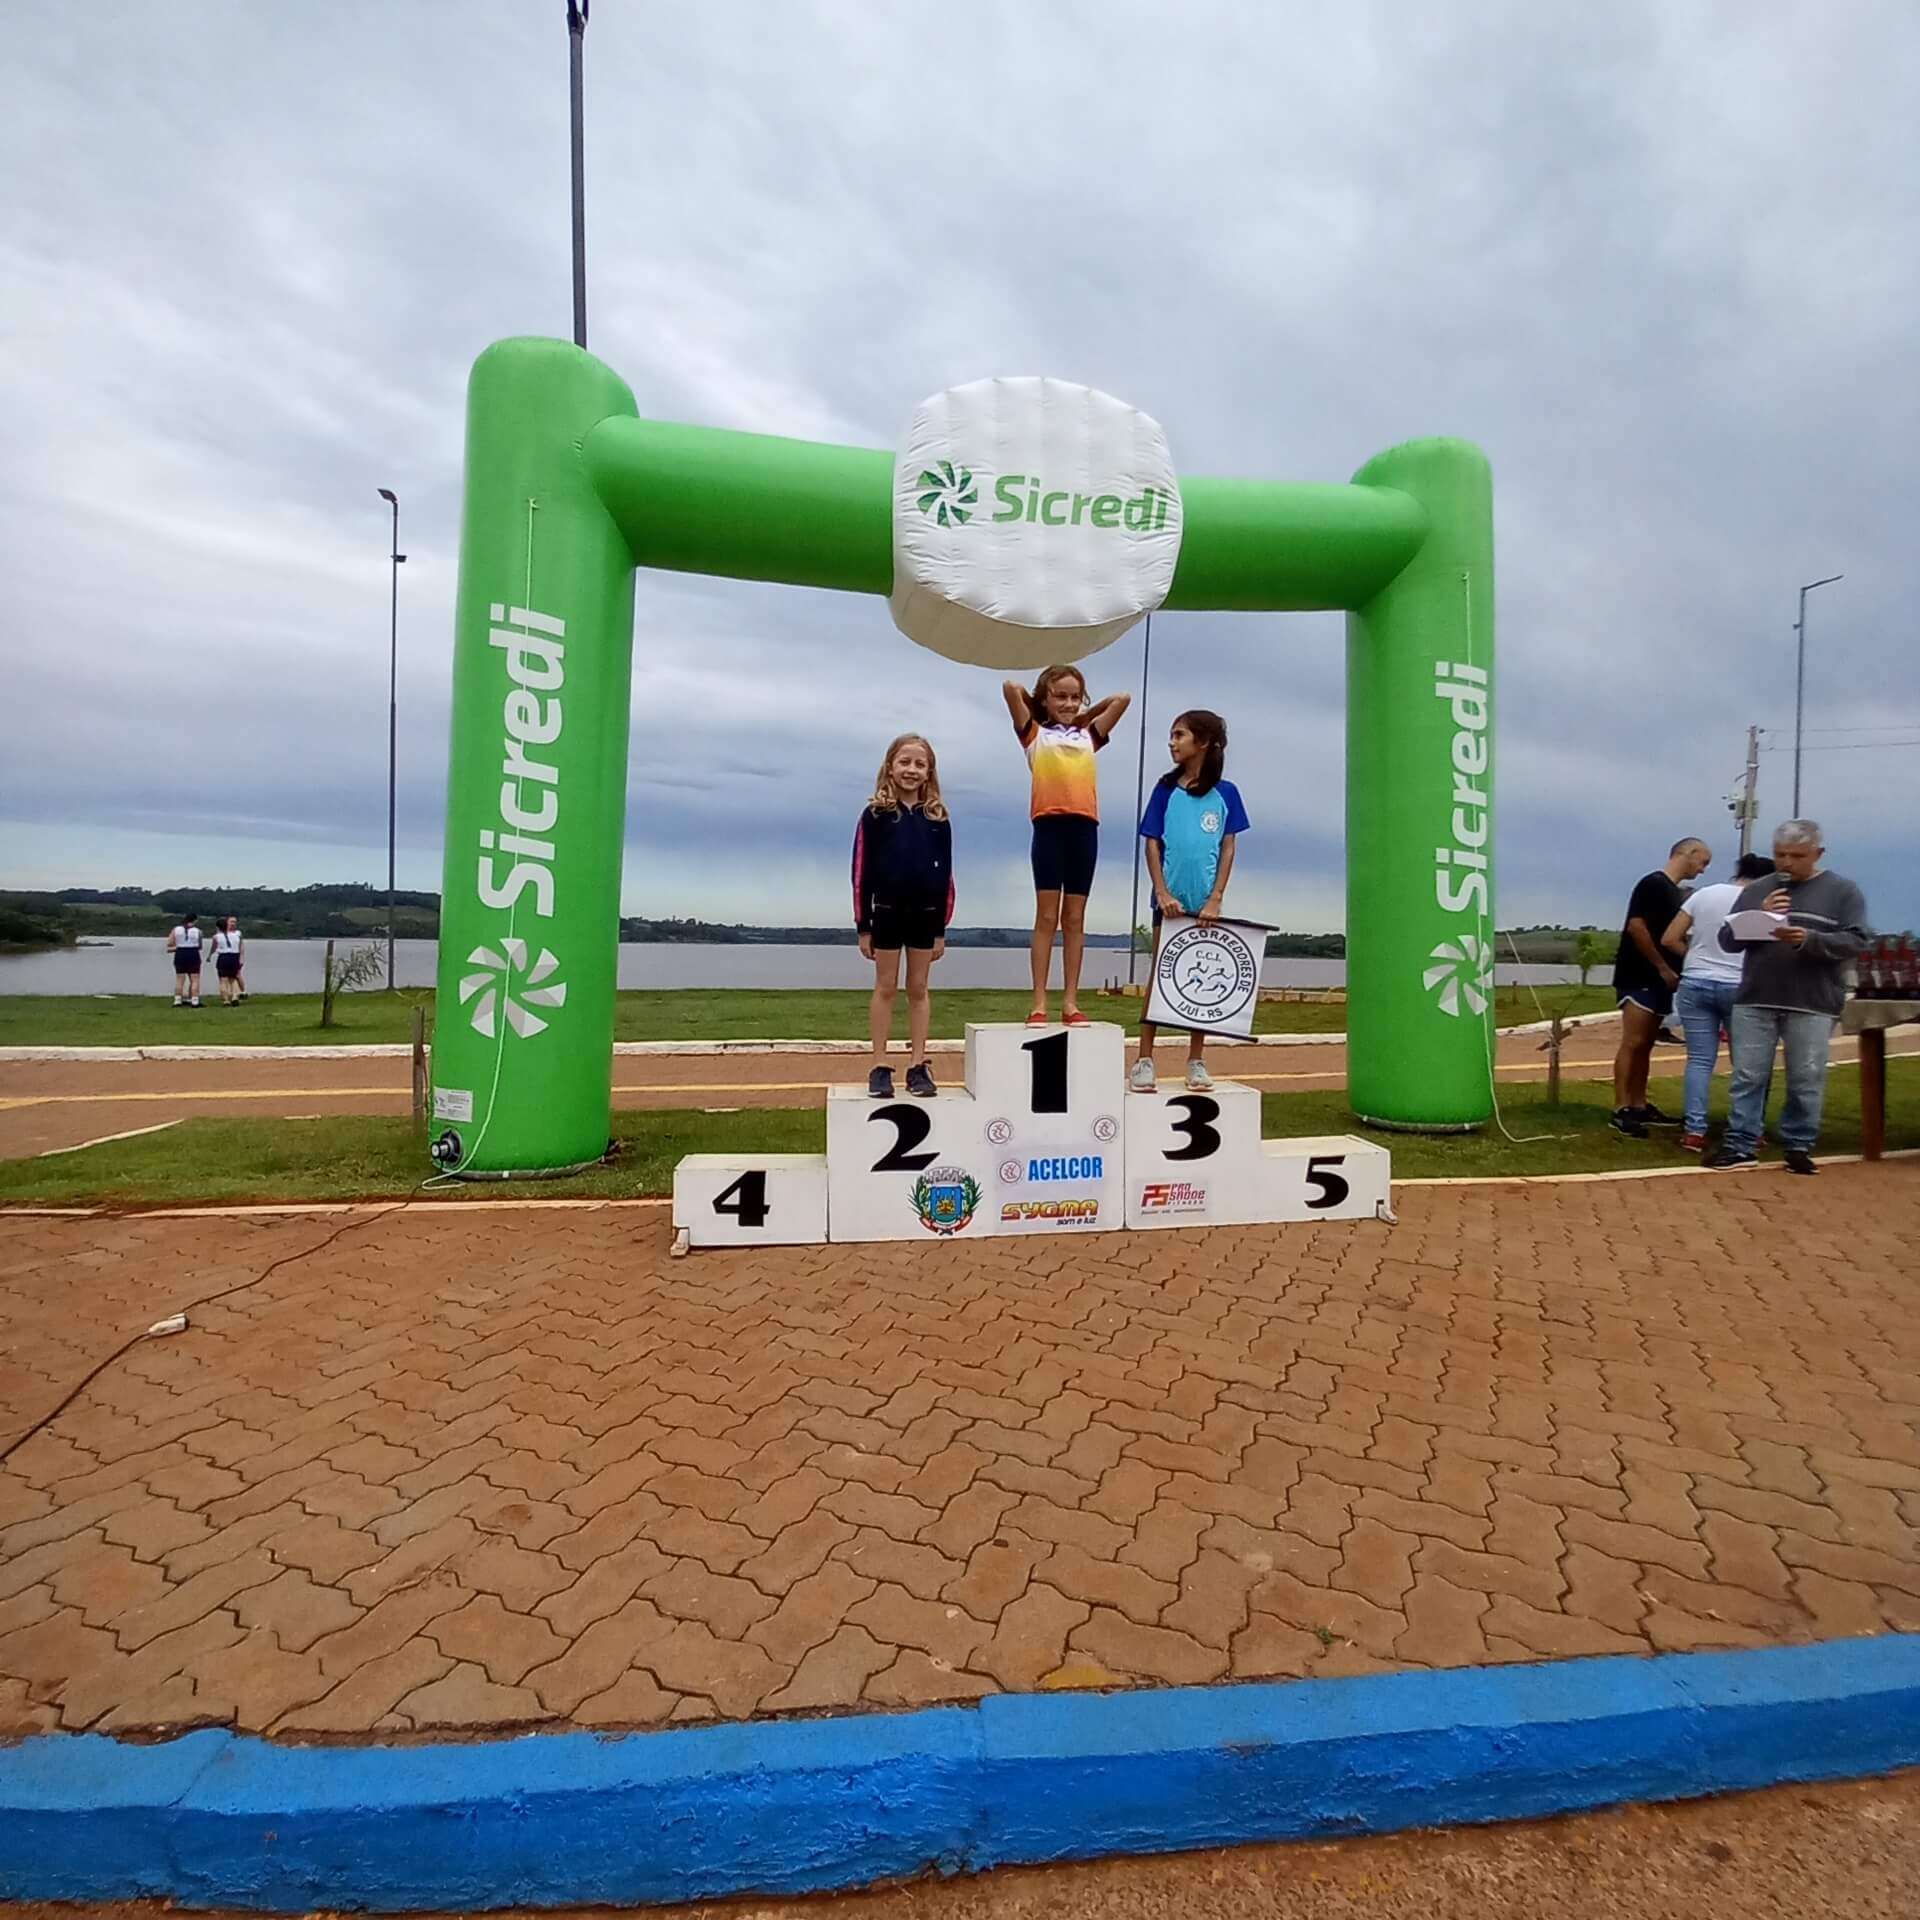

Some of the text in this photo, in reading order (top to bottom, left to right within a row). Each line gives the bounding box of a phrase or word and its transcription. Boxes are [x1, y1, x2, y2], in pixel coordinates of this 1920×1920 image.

[992, 475, 1170, 532] Sicredi
[478, 602, 567, 918] Sicredi
[1435, 660, 1488, 917] Sicredi
[1160, 929, 1252, 993] CLUBE DE CORREDORES DE
[1207, 1007, 1223, 1019] RS
[1021, 1032, 1069, 1114] 1
[867, 1103, 940, 1173] 2
[1162, 1095, 1221, 1161] 3
[712, 1170, 771, 1227] 4
[1028, 1156, 1103, 1181] ACELCOR
[1304, 1155, 1349, 1209] 5
[1000, 1199, 1099, 1221] SYGMA
